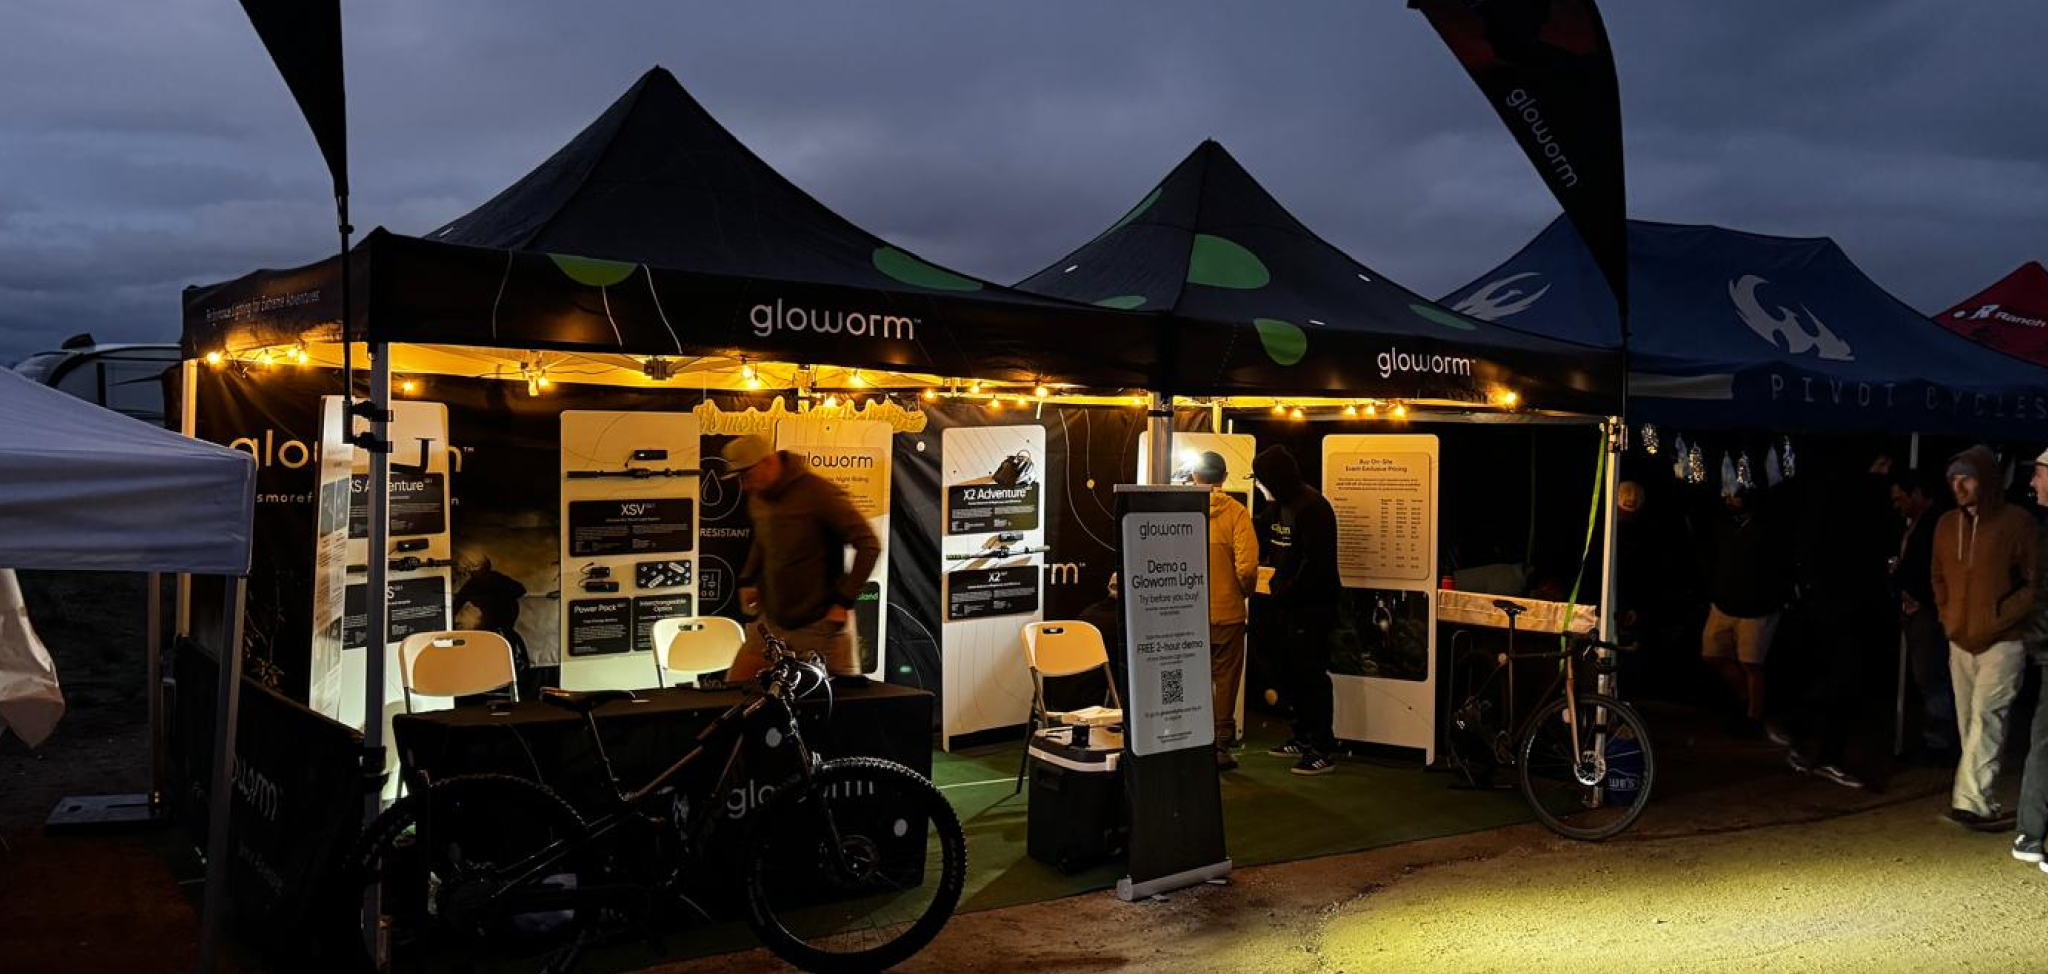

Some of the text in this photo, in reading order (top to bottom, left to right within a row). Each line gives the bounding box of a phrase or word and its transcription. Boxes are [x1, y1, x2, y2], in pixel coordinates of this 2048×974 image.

[1506, 88, 1577, 187] gloworm
[750, 299, 914, 340] gloworm
[1995, 311, 2047, 328] Ranch
[1377, 346, 1470, 378] gloworm
[1770, 373, 2048, 420] PIVOT CYCLES
[806, 451, 873, 468] loworm
[963, 486, 1026, 500] X2 Adventure
[621, 504, 645, 516] XSV
[700, 527, 750, 539] RESISTANT
[1139, 521, 1193, 540] gloworm
[1147, 560, 1187, 574] Demo a
[988, 572, 1001, 582] X2
[1132, 572, 1205, 590] Gloworm Light
[1139, 594, 1148, 605] Try
[1150, 593, 1171, 603] before
[1172, 594, 1183, 604] you
[573, 604, 598, 614] Power
[1137, 643, 1155, 654] FREE
[1182, 640, 1204, 650] demo
